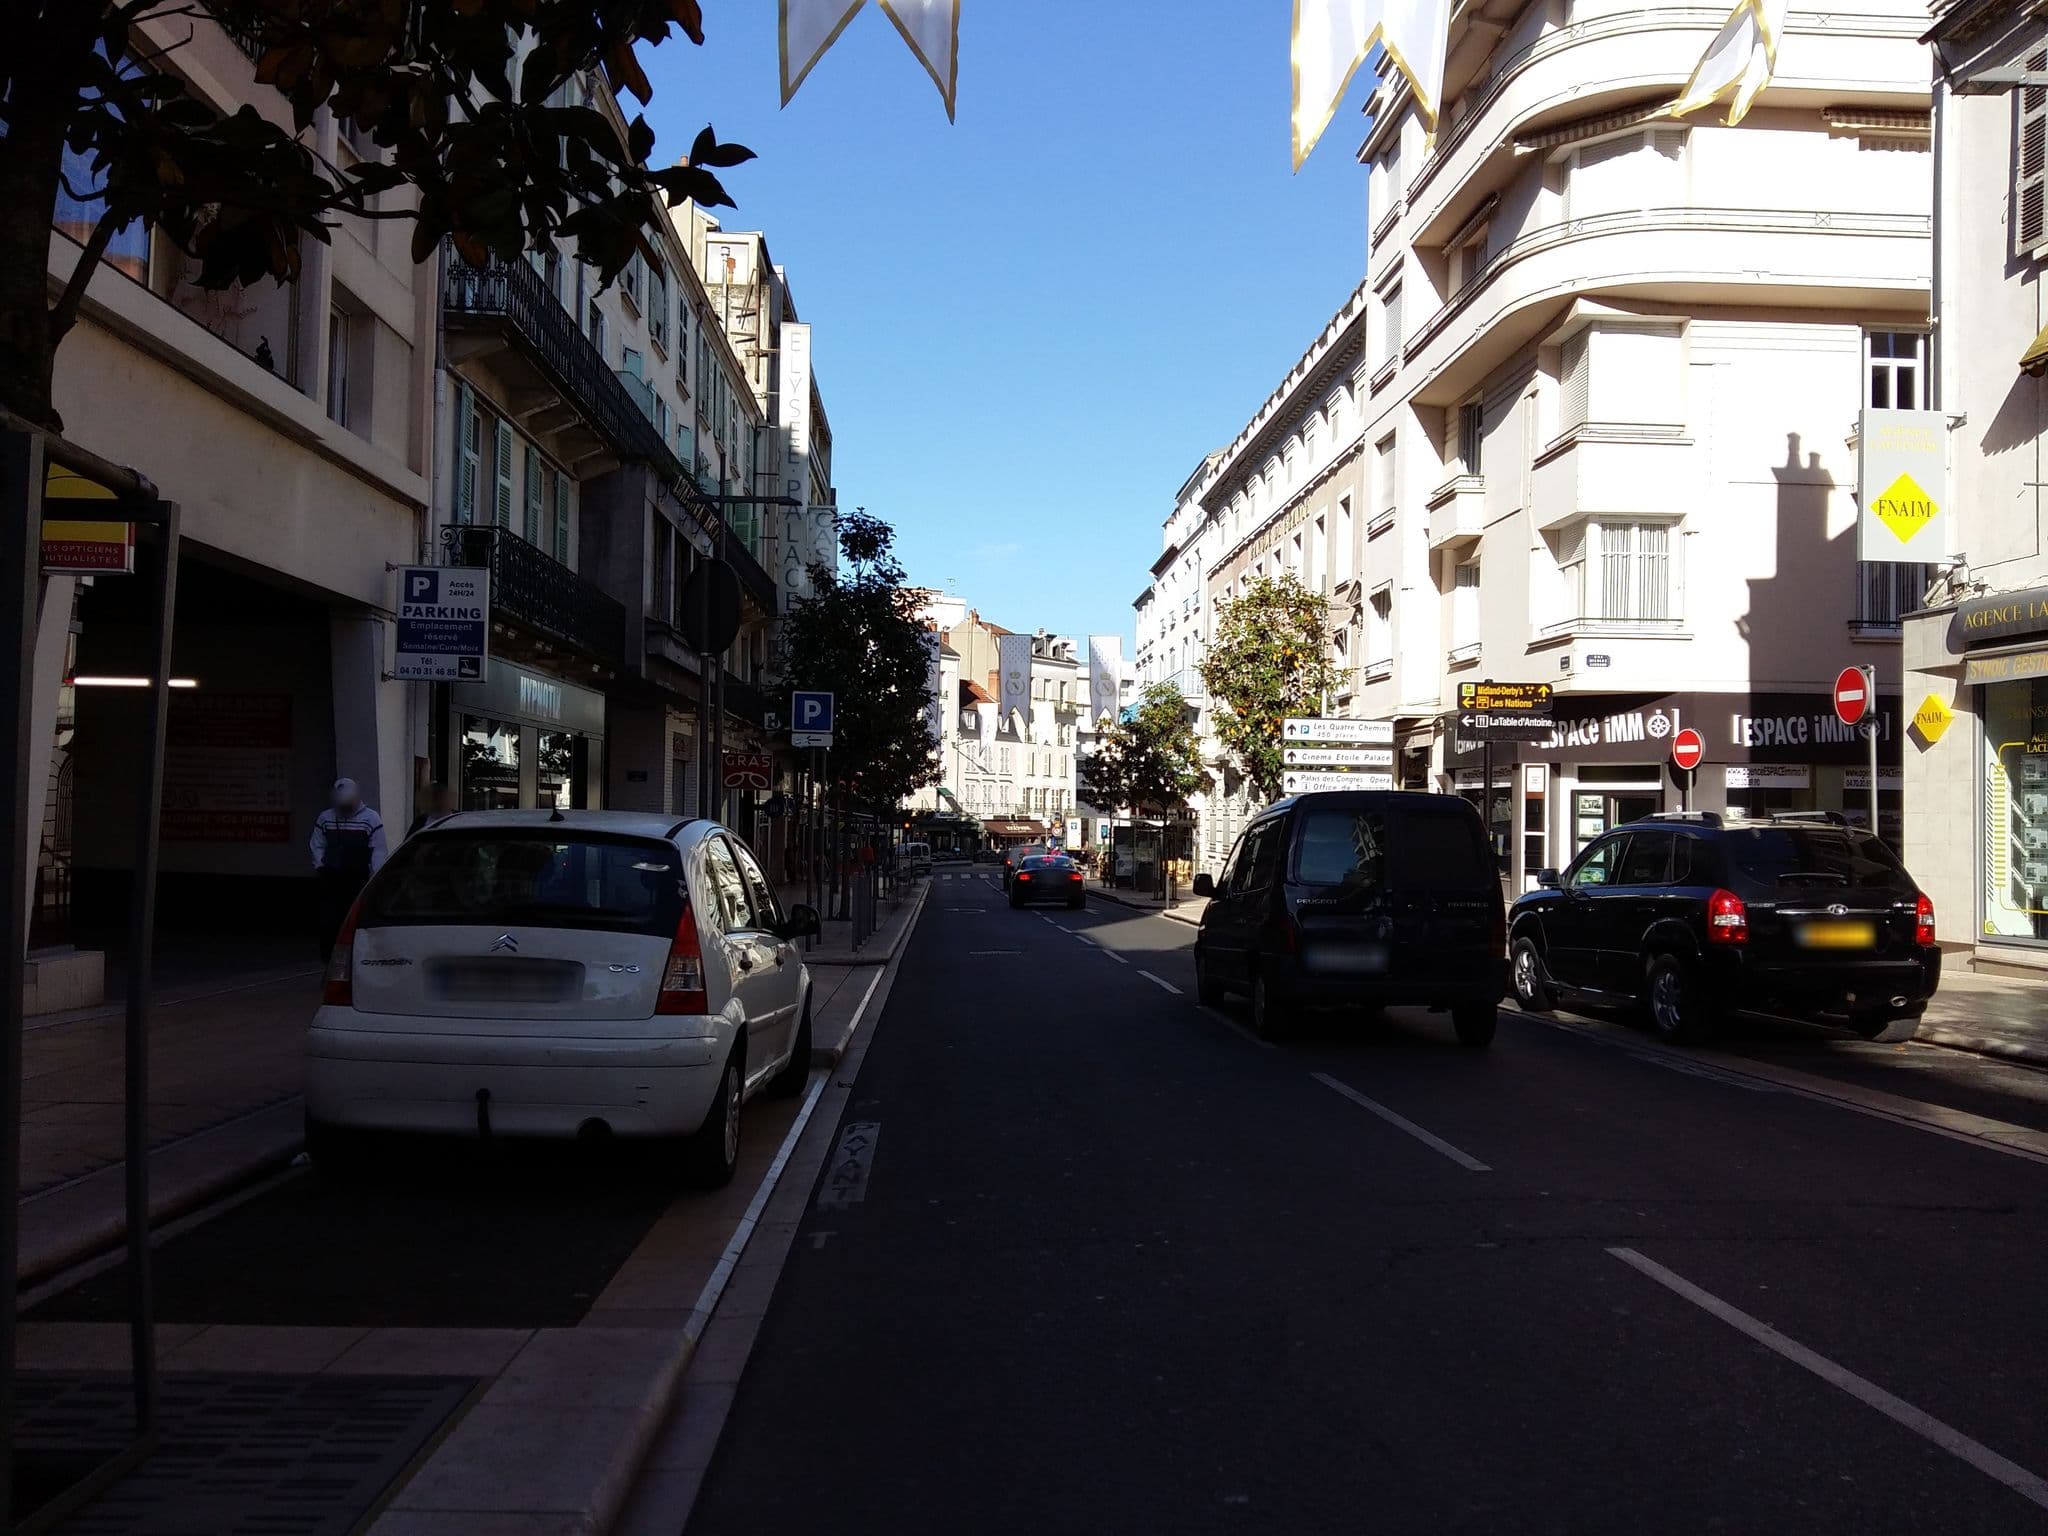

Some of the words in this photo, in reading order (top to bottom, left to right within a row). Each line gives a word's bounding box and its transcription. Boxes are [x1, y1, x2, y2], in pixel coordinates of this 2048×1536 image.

[1878, 499, 1931, 518] FNAIM
[61, 545, 120, 554] OPTICIENS
[784, 479, 802, 611] PALACE
[412, 576, 431, 597] P
[403, 605, 481, 619] PARKING
[1963, 604, 2022, 628] AGENCE
[410, 622, 473, 632] Emplacement
[424, 631, 458, 641] réservé
[1490, 698, 1503, 707] Les
[1504, 698, 1533, 708] Nations
[804, 699, 822, 725] P
[1916, 711, 1942, 725] FNAIM
[1329, 723, 1354, 731] Quatre
[1358, 724, 1391, 732] Chemins
[725, 755, 771, 768] GRAS
[1364, 754, 1391, 762] Palace
[1300, 774, 1320, 782] Palais
